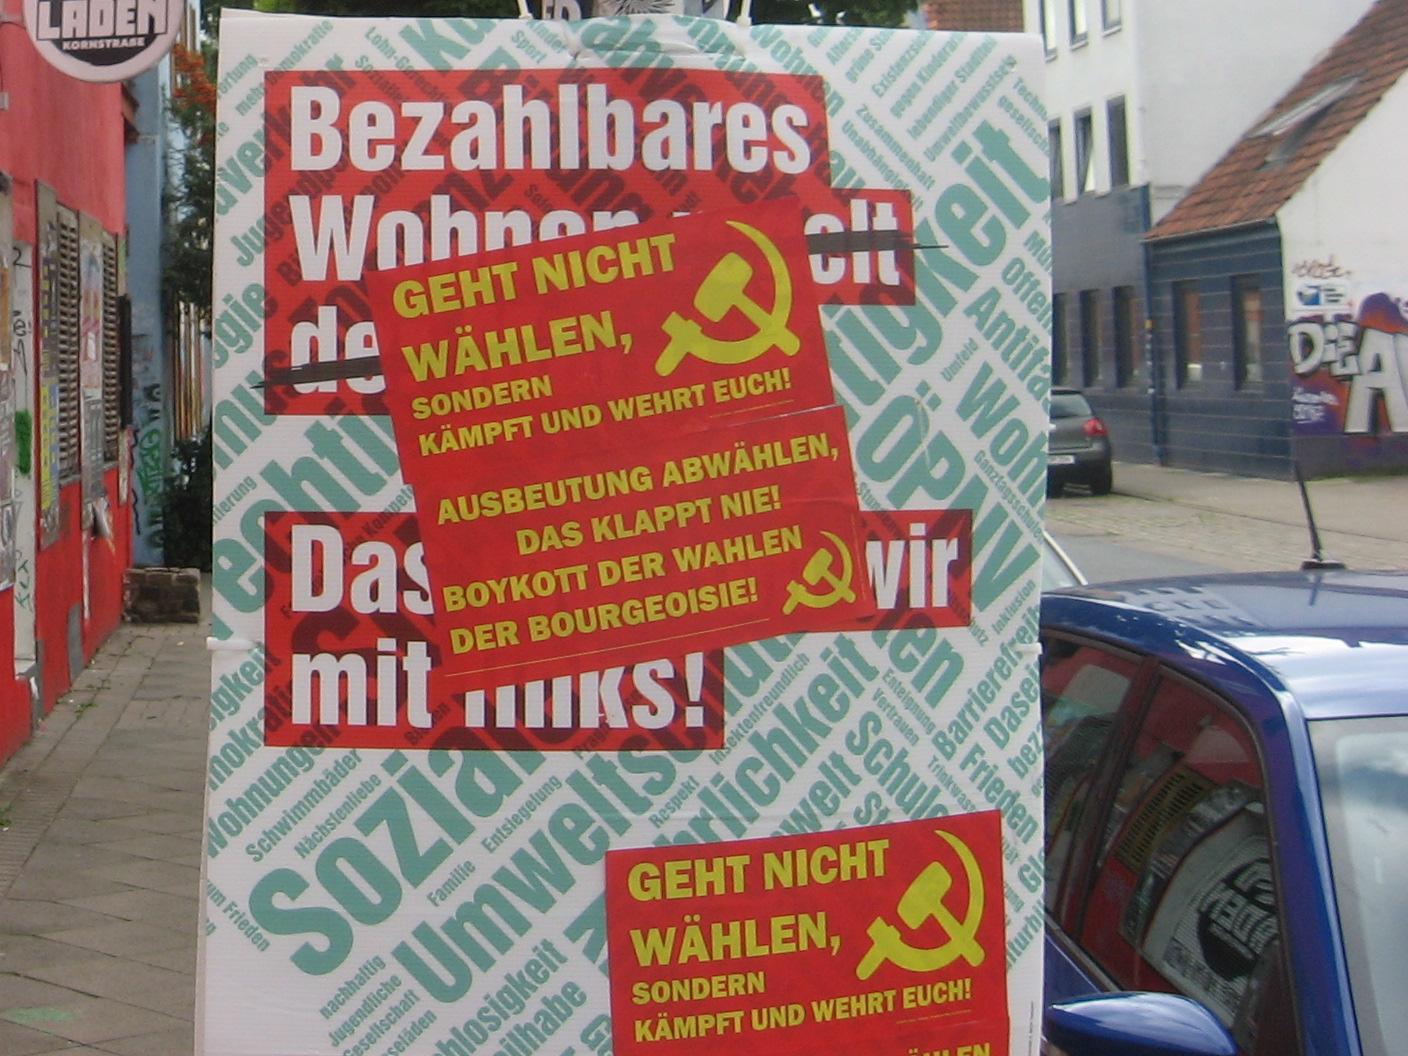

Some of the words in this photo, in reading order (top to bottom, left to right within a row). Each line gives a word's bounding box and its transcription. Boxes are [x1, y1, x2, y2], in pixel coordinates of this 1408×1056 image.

[291, 83, 812, 175] Bezahlbares
[393, 261, 519, 320] GEHT
[531, 233, 677, 295] NICHT
[401, 309, 634, 383] WÄHLEN,
[412, 375, 553, 420] SONDERN
[418, 416, 534, 457] KÄMPFT
[541, 404, 602, 435] UND
[607, 384, 706, 423] WEHRT
[712, 367, 791, 403] EUCH!
[437, 465, 653, 525] AUSBEUTUNG
[663, 432, 839, 488] ABWÄHLEN,
[516, 521, 583, 556] DAS
[591, 497, 713, 543] KLAPPT
[722, 485, 781, 518] NIE!
[291, 524, 435, 615] Das
[443, 564, 589, 613] BOYKOTT
[597, 551, 665, 587] DER
[672, 525, 803, 574] WAHLEN
[449, 620, 520, 655] DER
[528, 576, 758, 643] BOURGEOISIE!
[291, 637, 432, 729] mit
[873, 687, 920, 747] Vertrauen
[882, 668, 937, 737] Enteignung
[245, 749, 363, 863] Schwimmbäder
[294, 773, 382, 859] Nächstenliebe
[481, 775, 562, 854] Entsiegelung
[648, 774, 700, 829] Respekt
[959, 742, 1039, 845] Frieden
[427, 860, 476, 907] Familie
[627, 852, 751, 902] GEHT
[764, 839, 891, 891] NICHT
[630, 912, 841, 968] WÄHLEN,
[319, 954, 387, 1021] nachhaltig
[328, 974, 403, 1048] Jugendliche
[631, 972, 766, 1005] SONDERN
[634, 1011, 745, 1043] KÄMPFT
[752, 1004, 806, 1029] UND
[812, 989, 897, 1024] WEHRT
[902, 978, 972, 1010] EUCH!
